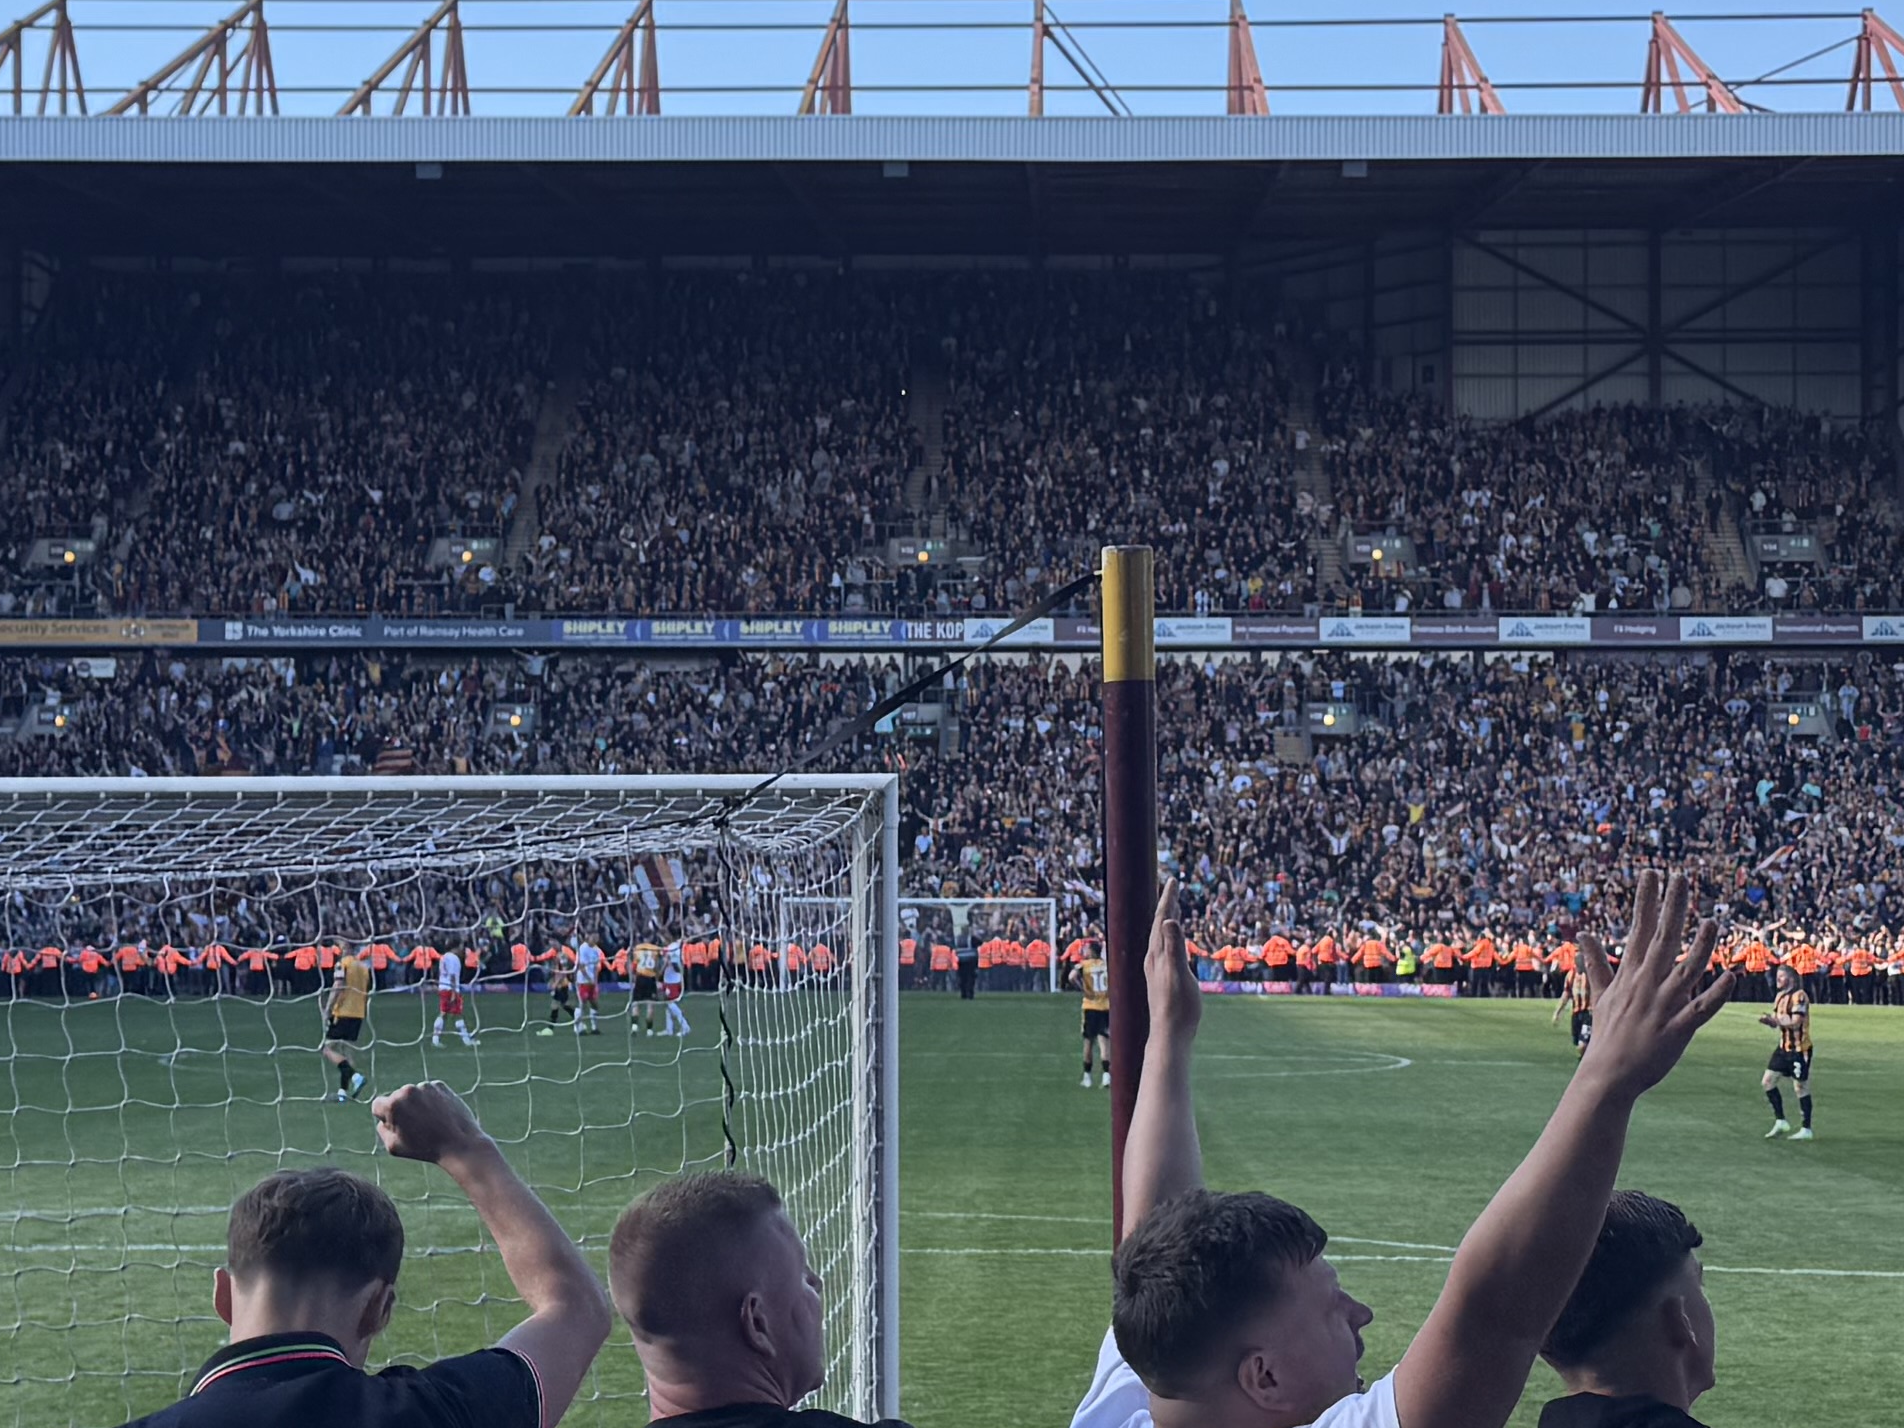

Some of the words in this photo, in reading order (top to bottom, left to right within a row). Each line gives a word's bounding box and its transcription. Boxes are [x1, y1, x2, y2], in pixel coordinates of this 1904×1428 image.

[50, 620, 109, 635] Services
[247, 625, 269, 638] The
[272, 625, 326, 638] Yorkshire
[329, 625, 362, 638] Clinic
[384, 625, 403, 637] Part
[406, 625, 418, 637] of
[420, 626, 459, 640] Ramsay
[462, 626, 496, 638] Health
[499, 626, 524, 638] Care
[563, 621, 626, 634] SHIPLEY
[651, 621, 715, 634] SHIPLEY
[739, 621, 803, 634] SHIPLEY
[828, 621, 892, 634] SHIPLEY
[906, 622, 932, 639] THE
[936, 622, 964, 639] KOP
